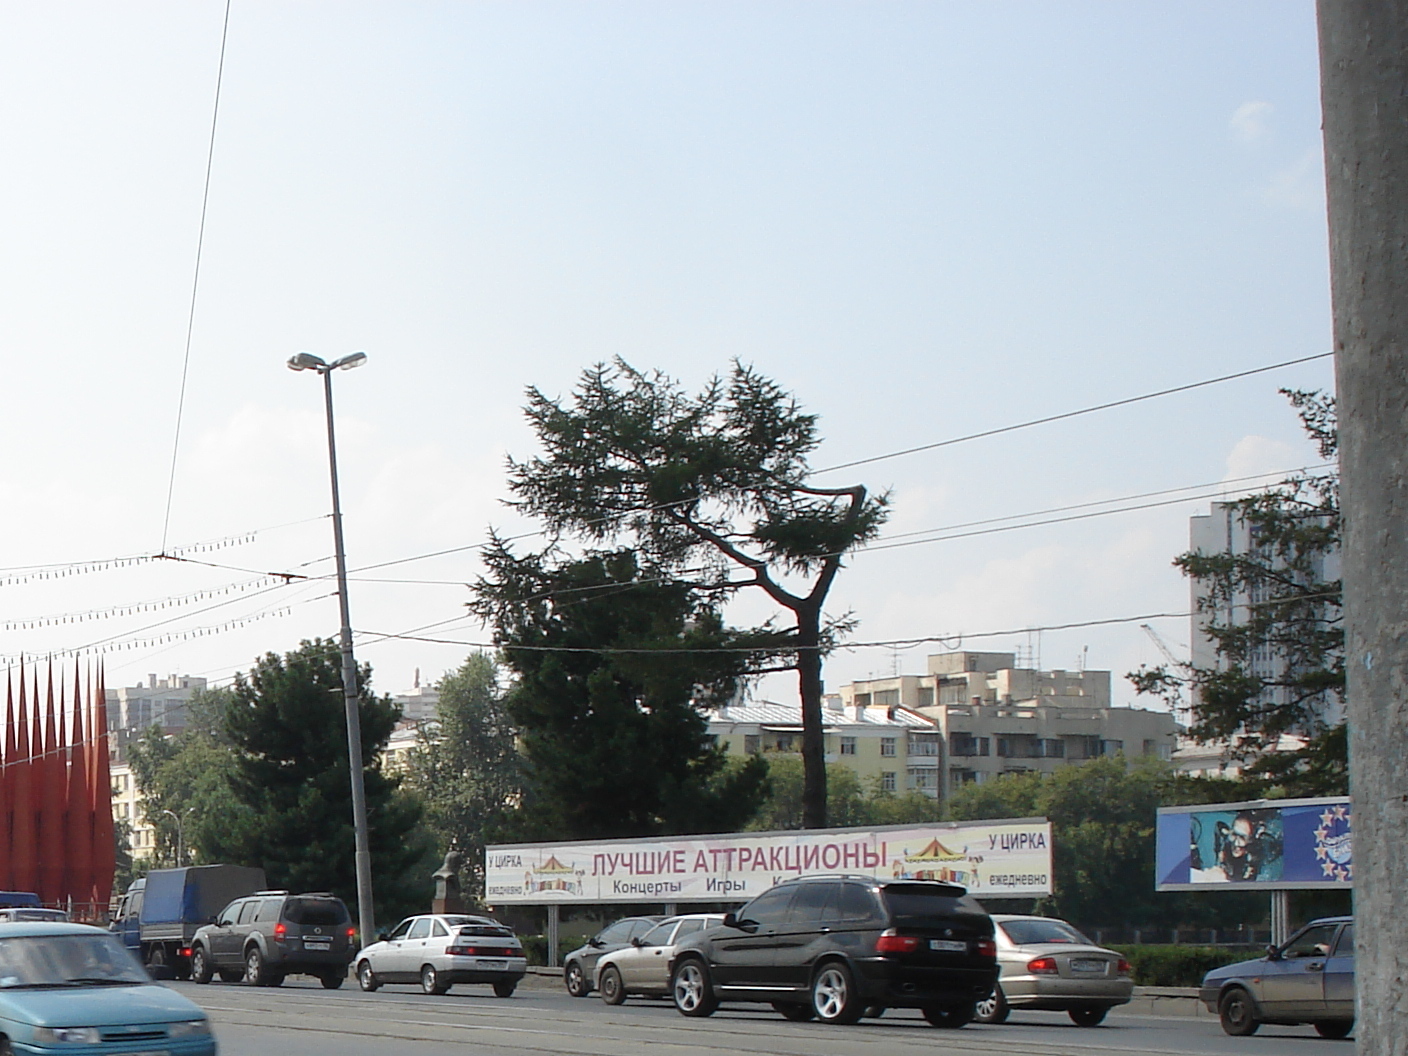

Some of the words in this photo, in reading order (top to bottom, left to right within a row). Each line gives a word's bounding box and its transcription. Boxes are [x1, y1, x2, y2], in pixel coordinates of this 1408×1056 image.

[989, 834, 998, 850] У
[1000, 832, 1046, 852] ЦИРКА
[488, 857, 494, 869] У
[495, 854, 523, 870] ЦИРКА
[592, 850, 687, 877] ЛУЧШИЕ
[693, 841, 887, 875] АТТРАКЦИОНЫ
[613, 880, 682, 896] Концерты
[706, 878, 746, 894] Игры
[989, 873, 1047, 888] ежедневно
[488, 886, 523, 896] ежедневно
